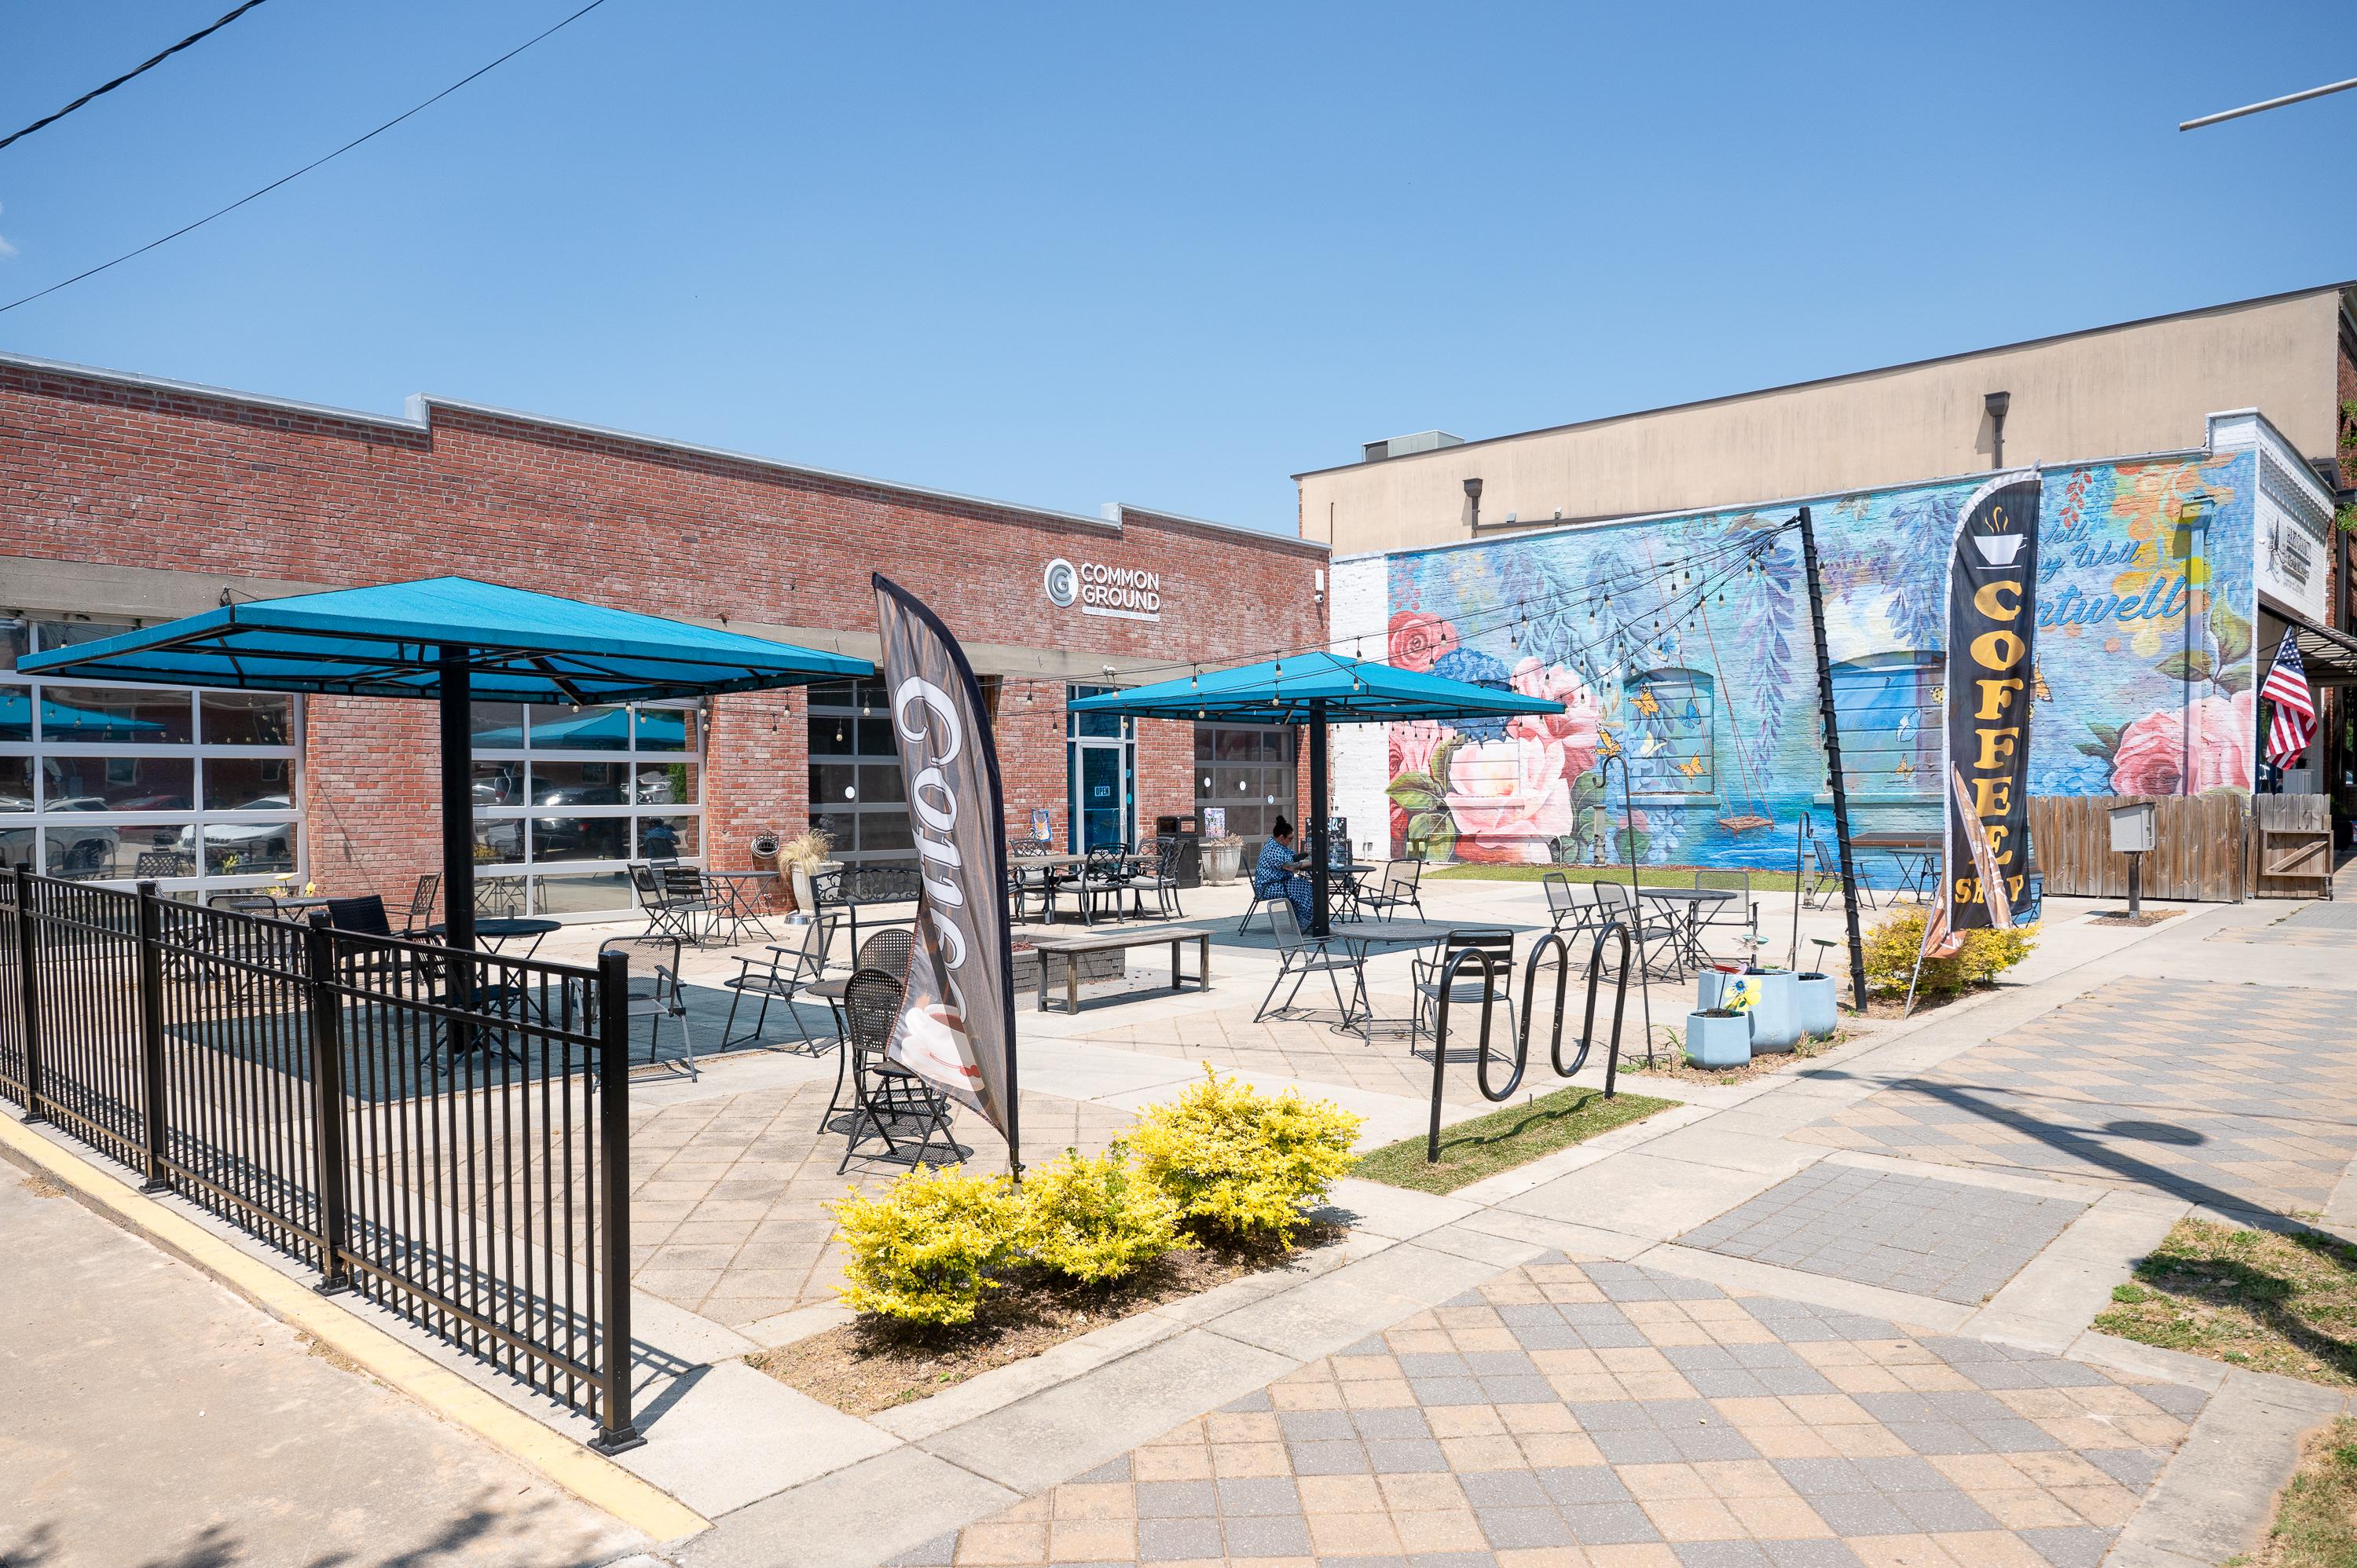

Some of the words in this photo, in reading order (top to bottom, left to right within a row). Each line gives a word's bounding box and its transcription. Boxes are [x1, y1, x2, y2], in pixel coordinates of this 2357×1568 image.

[2070, 540, 2144, 568] Well.
[1080, 562, 1160, 592] COMMON
[1082, 584, 1160, 610] GROUND
[1096, 786, 1109, 796] OPEN
[1955, 874, 2023, 903] SHP
